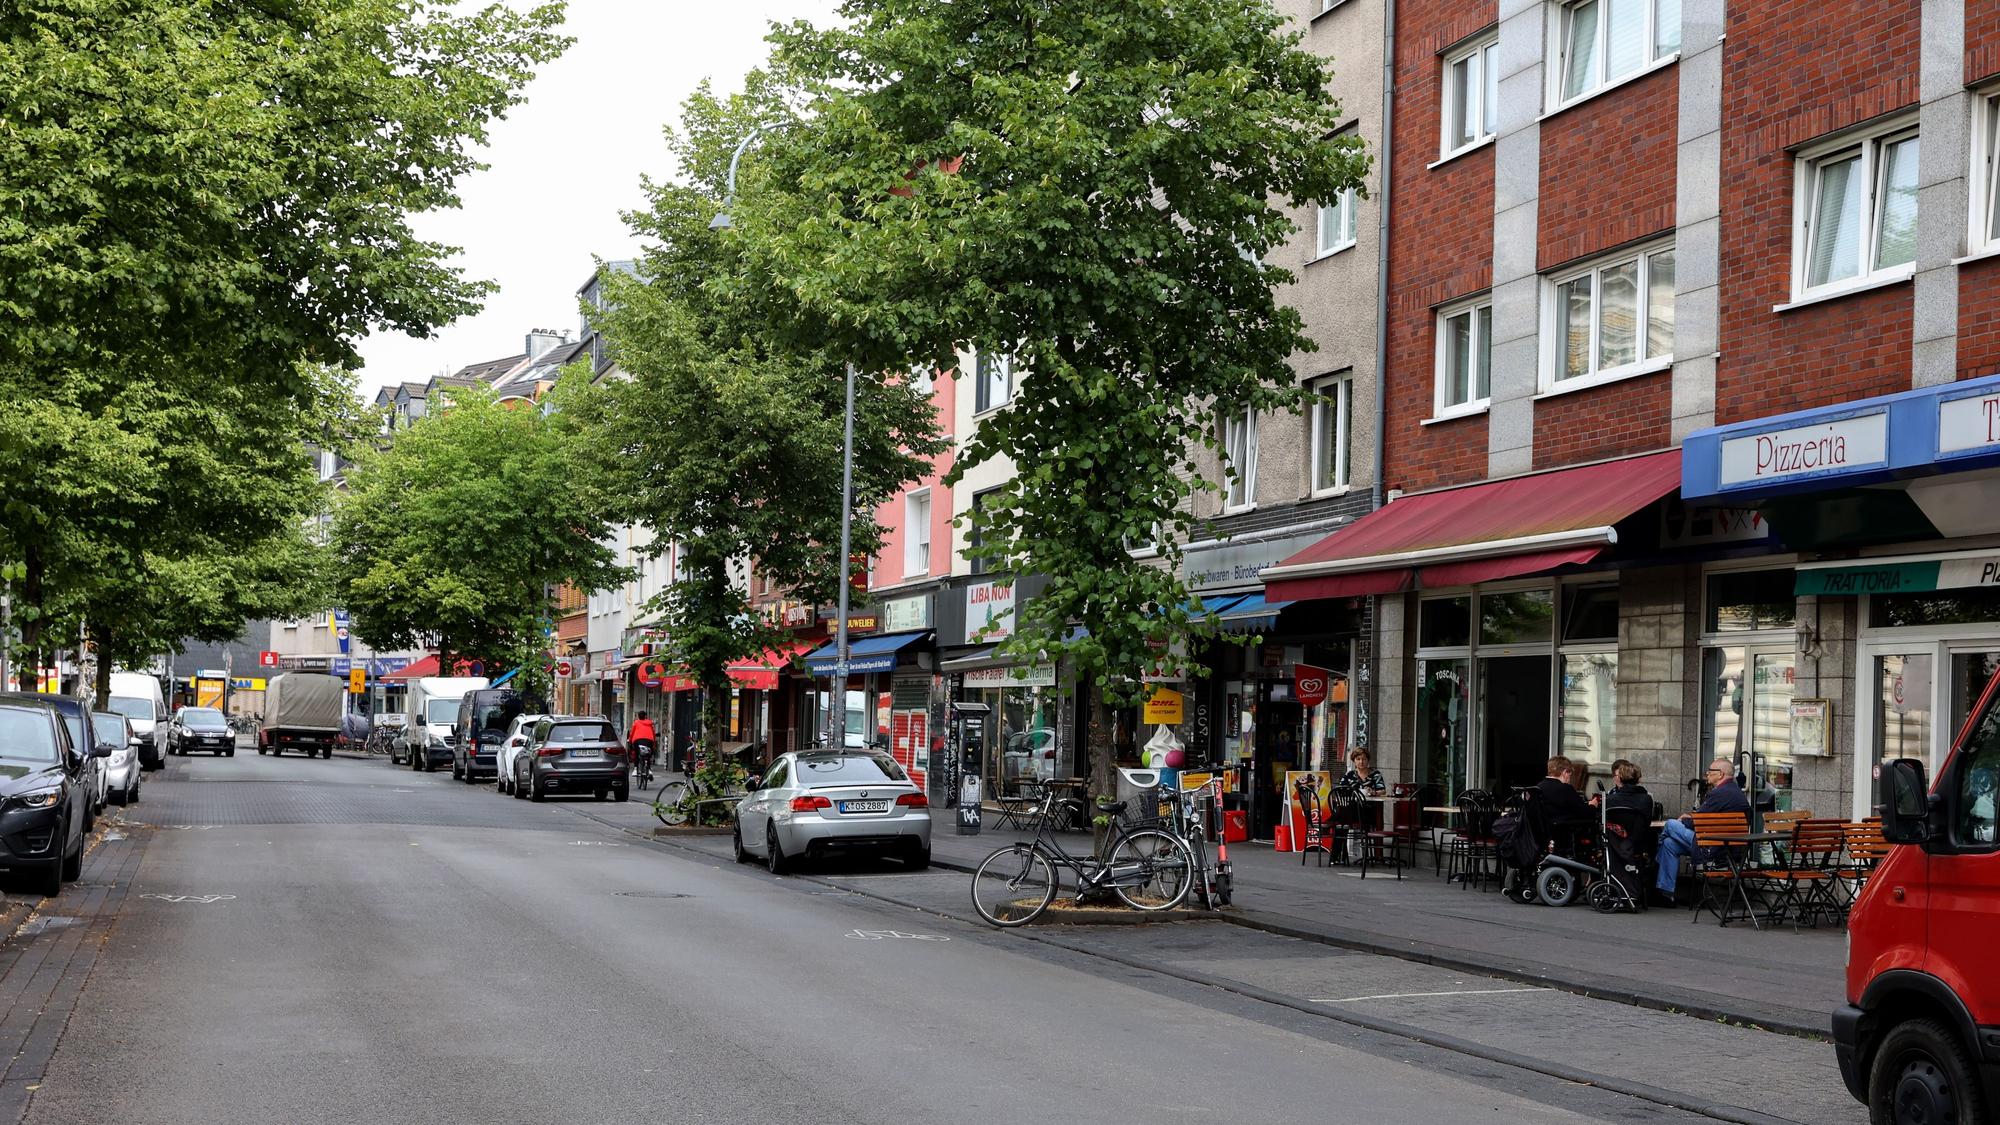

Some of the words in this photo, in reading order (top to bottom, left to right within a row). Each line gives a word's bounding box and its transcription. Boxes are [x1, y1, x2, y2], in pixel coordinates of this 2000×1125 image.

[1982, 396, 2000, 443] T
[1755, 426, 1846, 475] Pizzeria
[1823, 569, 1901, 592] TRATTORIA
[1435, 669, 1460, 686] TOSCANA
[855, 802, 866, 810] OS
[866, 801, 886, 810] 2887
